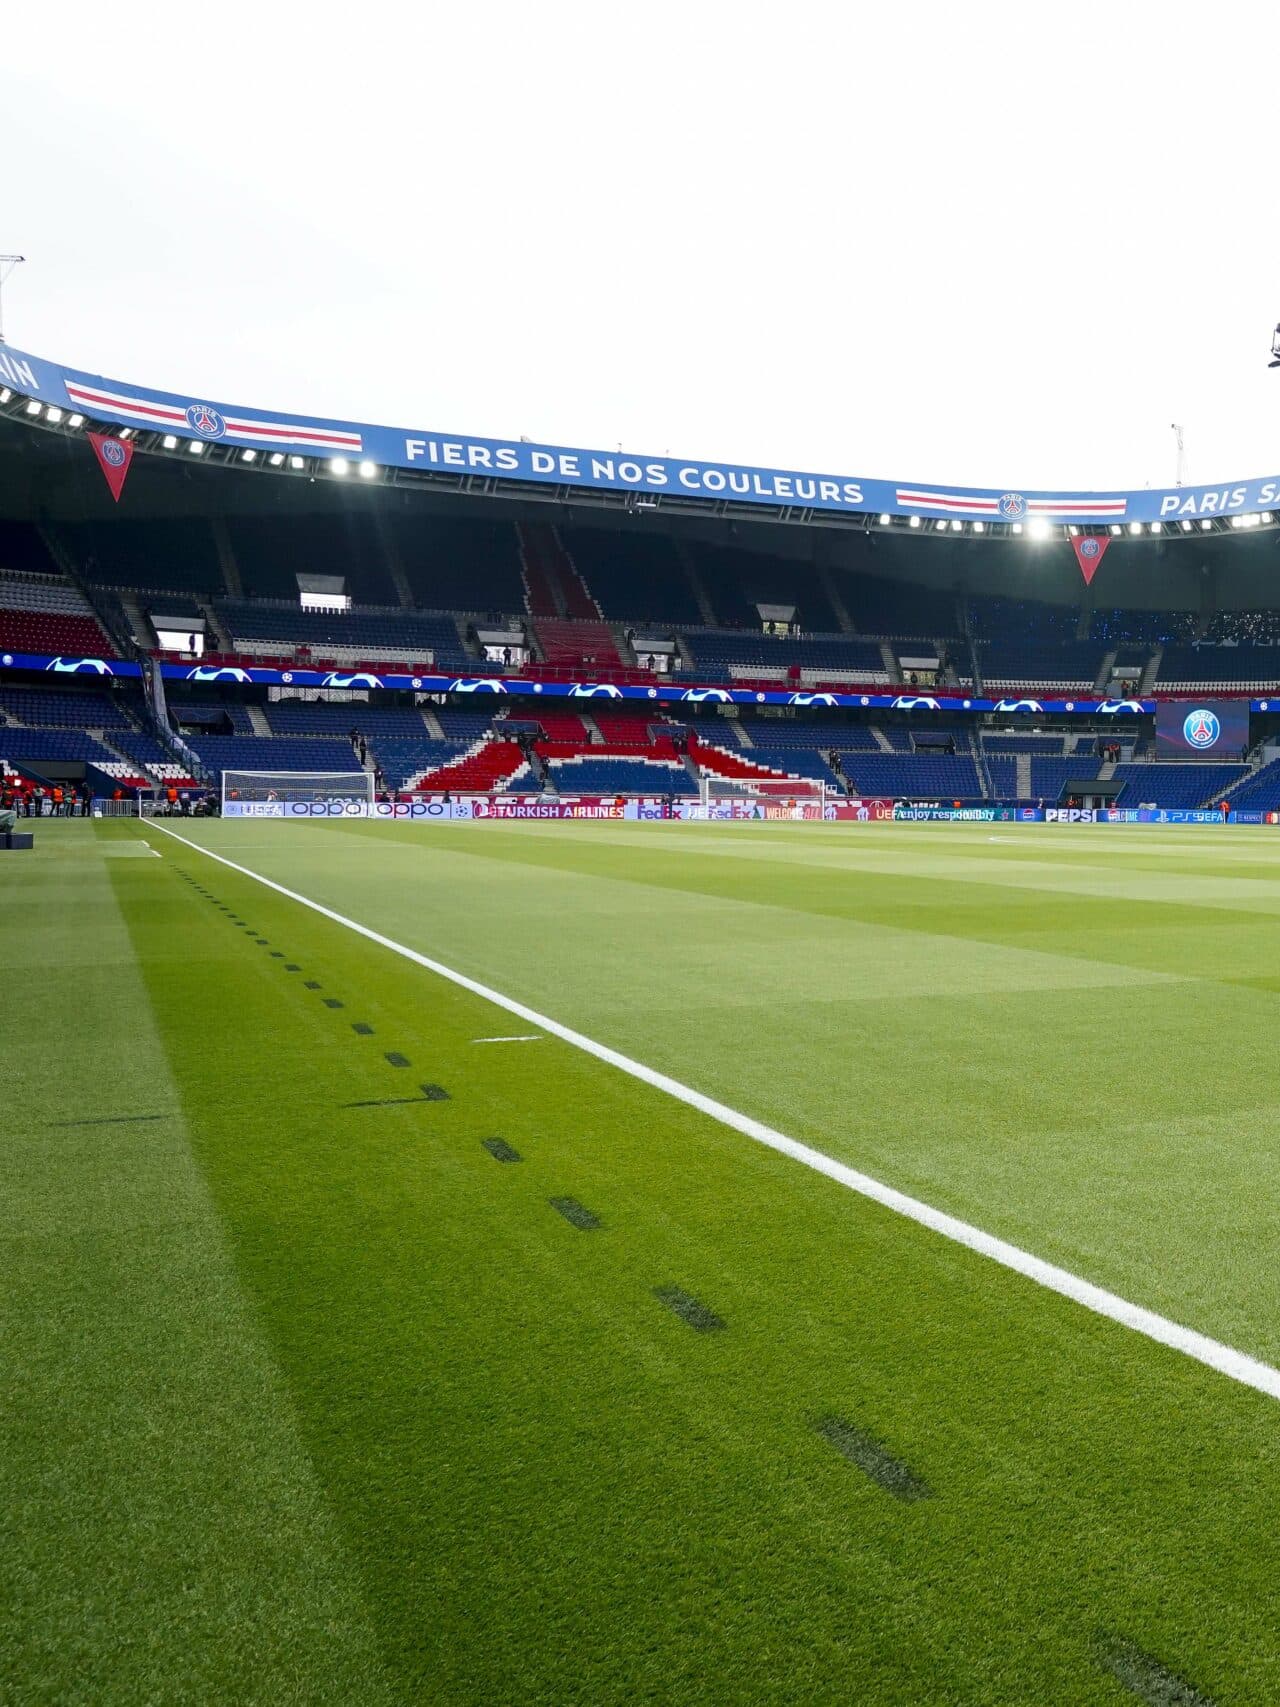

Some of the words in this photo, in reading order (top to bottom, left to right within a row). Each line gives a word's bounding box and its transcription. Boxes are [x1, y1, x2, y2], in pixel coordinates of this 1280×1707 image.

[406, 439, 519, 470] FIERS
[531, 452, 581, 477] DE
[593, 458, 668, 485] NOS
[679, 467, 864, 503] COULEURS
[1160, 488, 1247, 516] PARIS
[292, 803, 361, 816] oppo
[377, 804, 443, 819] oppo
[497, 806, 559, 818] TURKISH
[564, 806, 624, 819] AIRLINES
[638, 806, 682, 820] FedEx
[901, 809, 930, 821] enjoy
[1046, 808, 1097, 822] PEPSI
